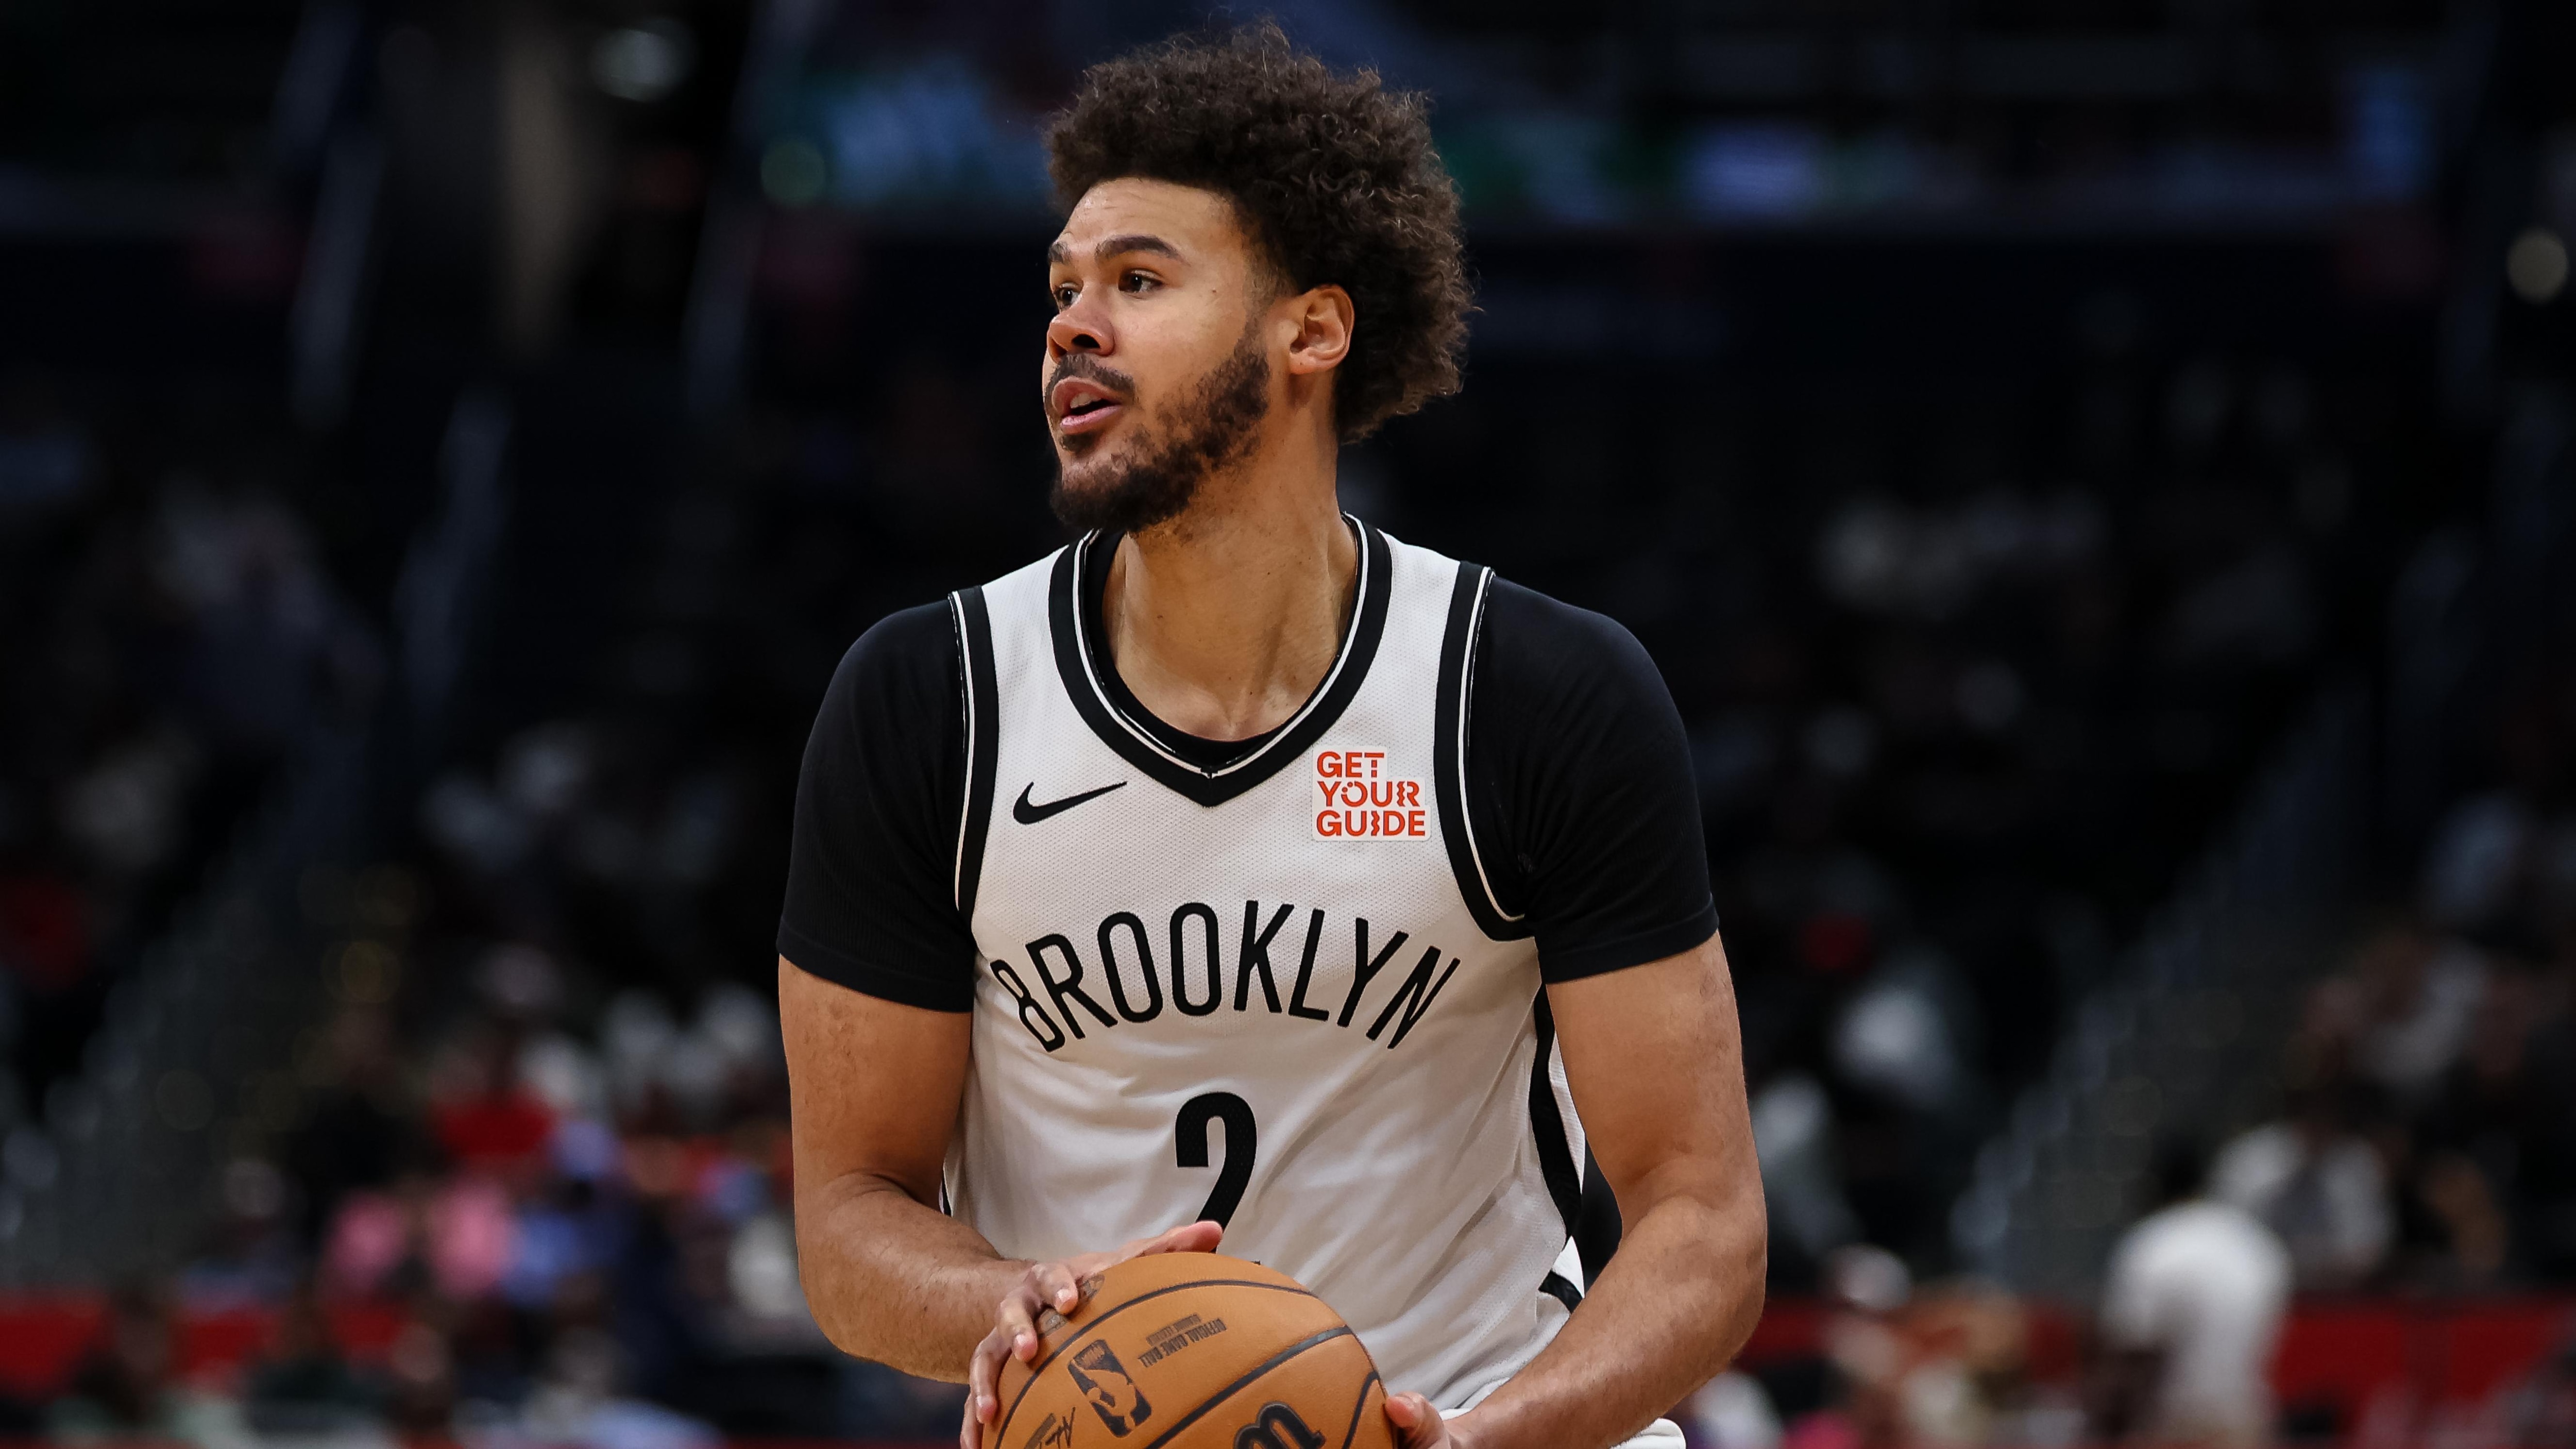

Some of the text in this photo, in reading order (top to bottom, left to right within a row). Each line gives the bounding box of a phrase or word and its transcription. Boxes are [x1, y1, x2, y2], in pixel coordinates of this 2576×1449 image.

[1317, 751, 1384, 778] GET
[1317, 781, 1420, 807] YOUR
[1316, 810, 1425, 837] GUIDE
[990, 900, 1461, 1052] BROOKLYN
[1175, 1091, 1258, 1257] 2
